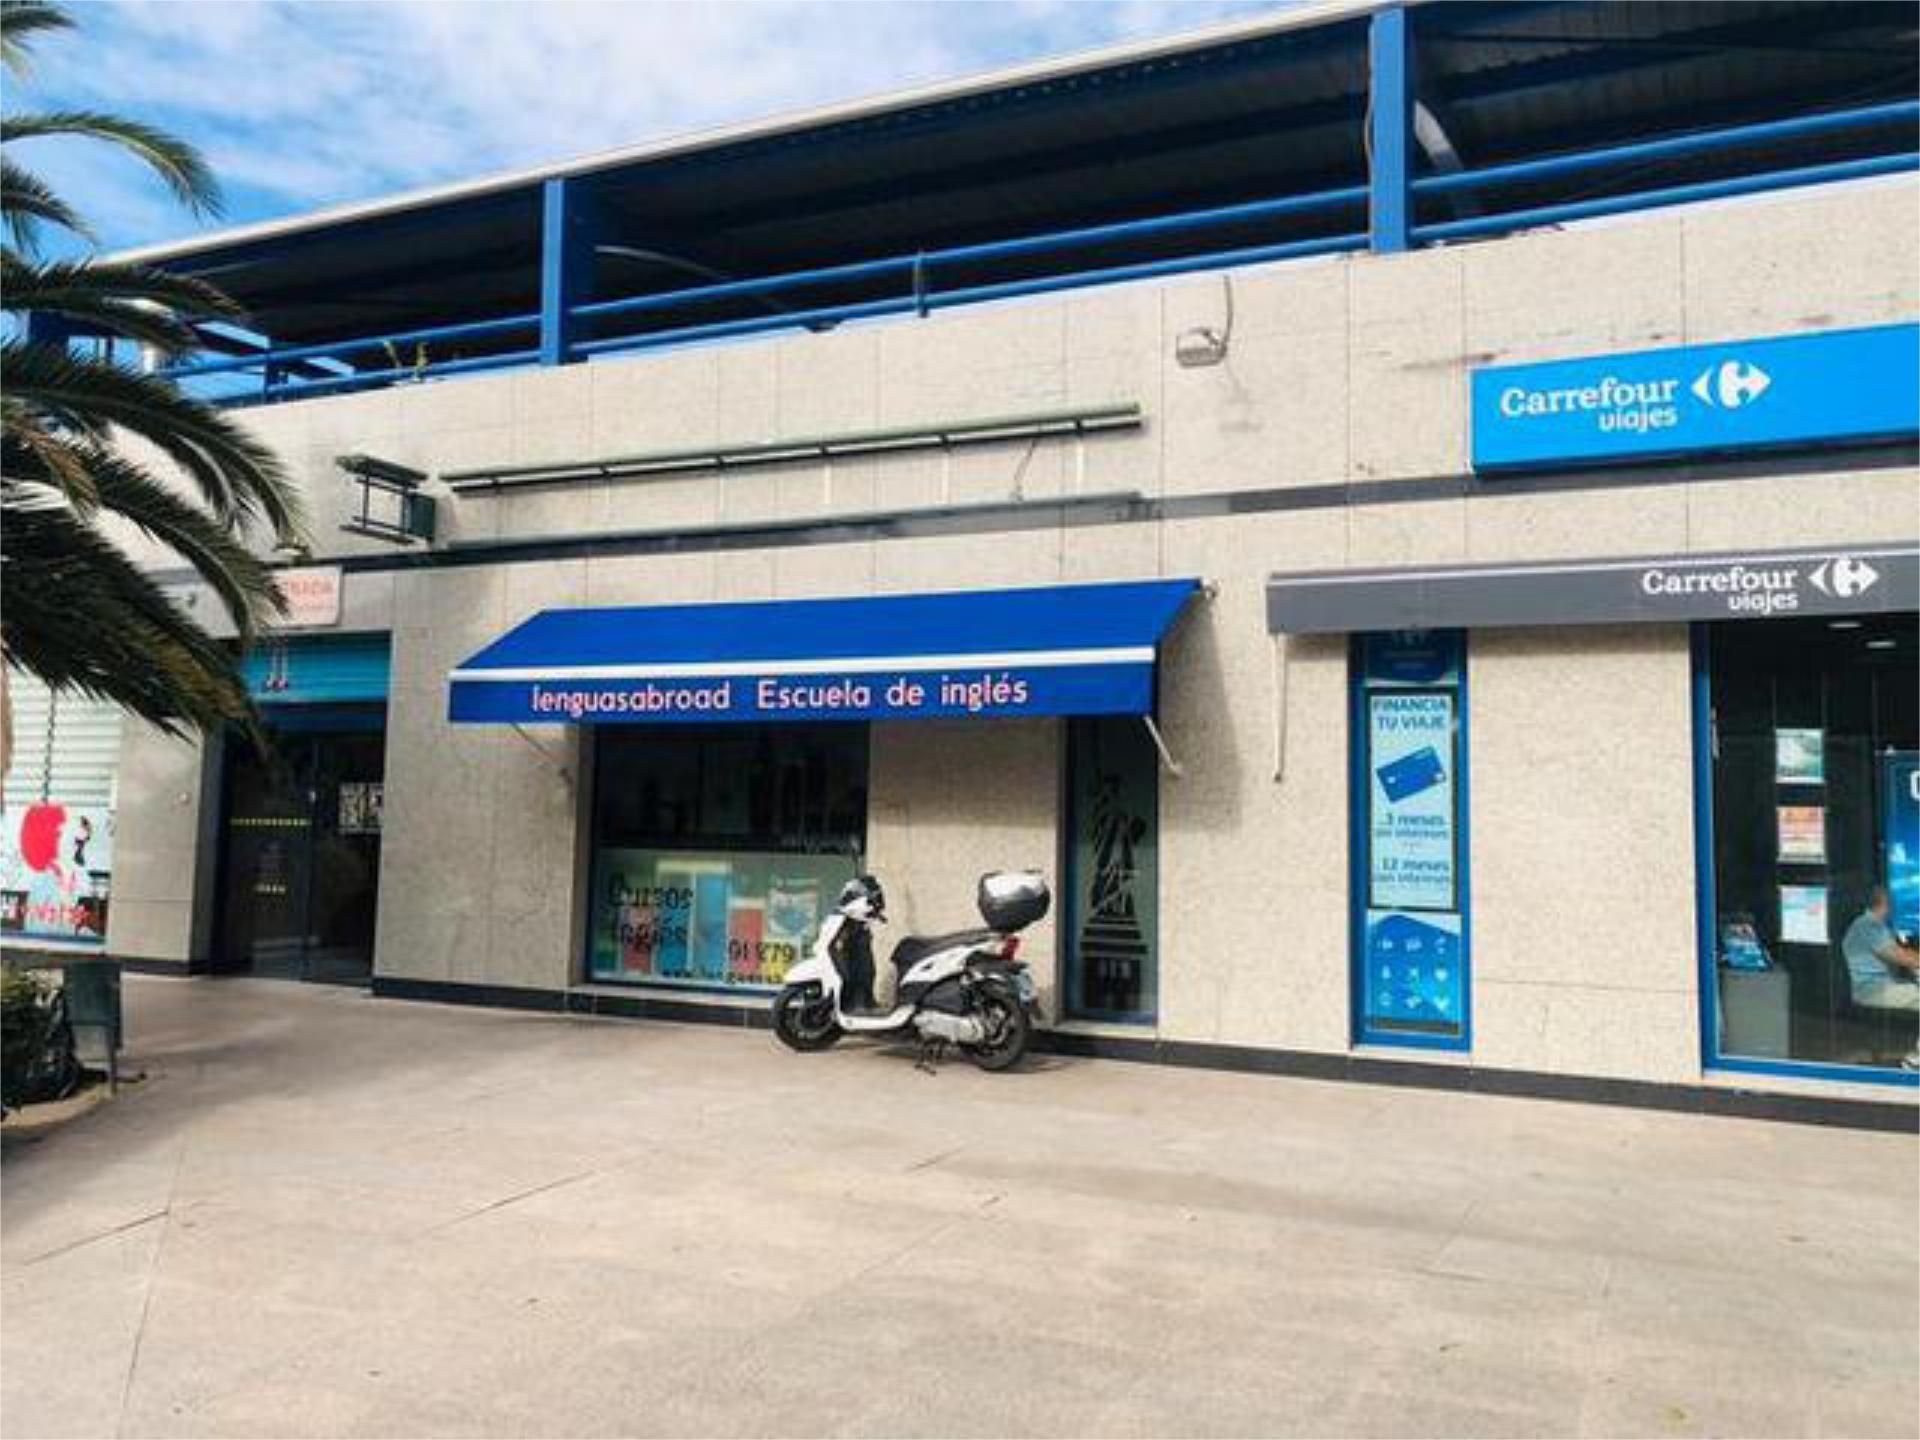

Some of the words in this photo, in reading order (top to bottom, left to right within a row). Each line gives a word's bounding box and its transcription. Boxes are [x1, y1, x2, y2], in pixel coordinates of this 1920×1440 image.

[1500, 377, 1679, 417] Carrefour
[1643, 566, 1798, 594] Carrefour
[533, 682, 730, 718] lenguasabroad
[757, 678, 871, 709] Escuela
[886, 677, 925, 707] de
[941, 674, 1027, 711] inglés
